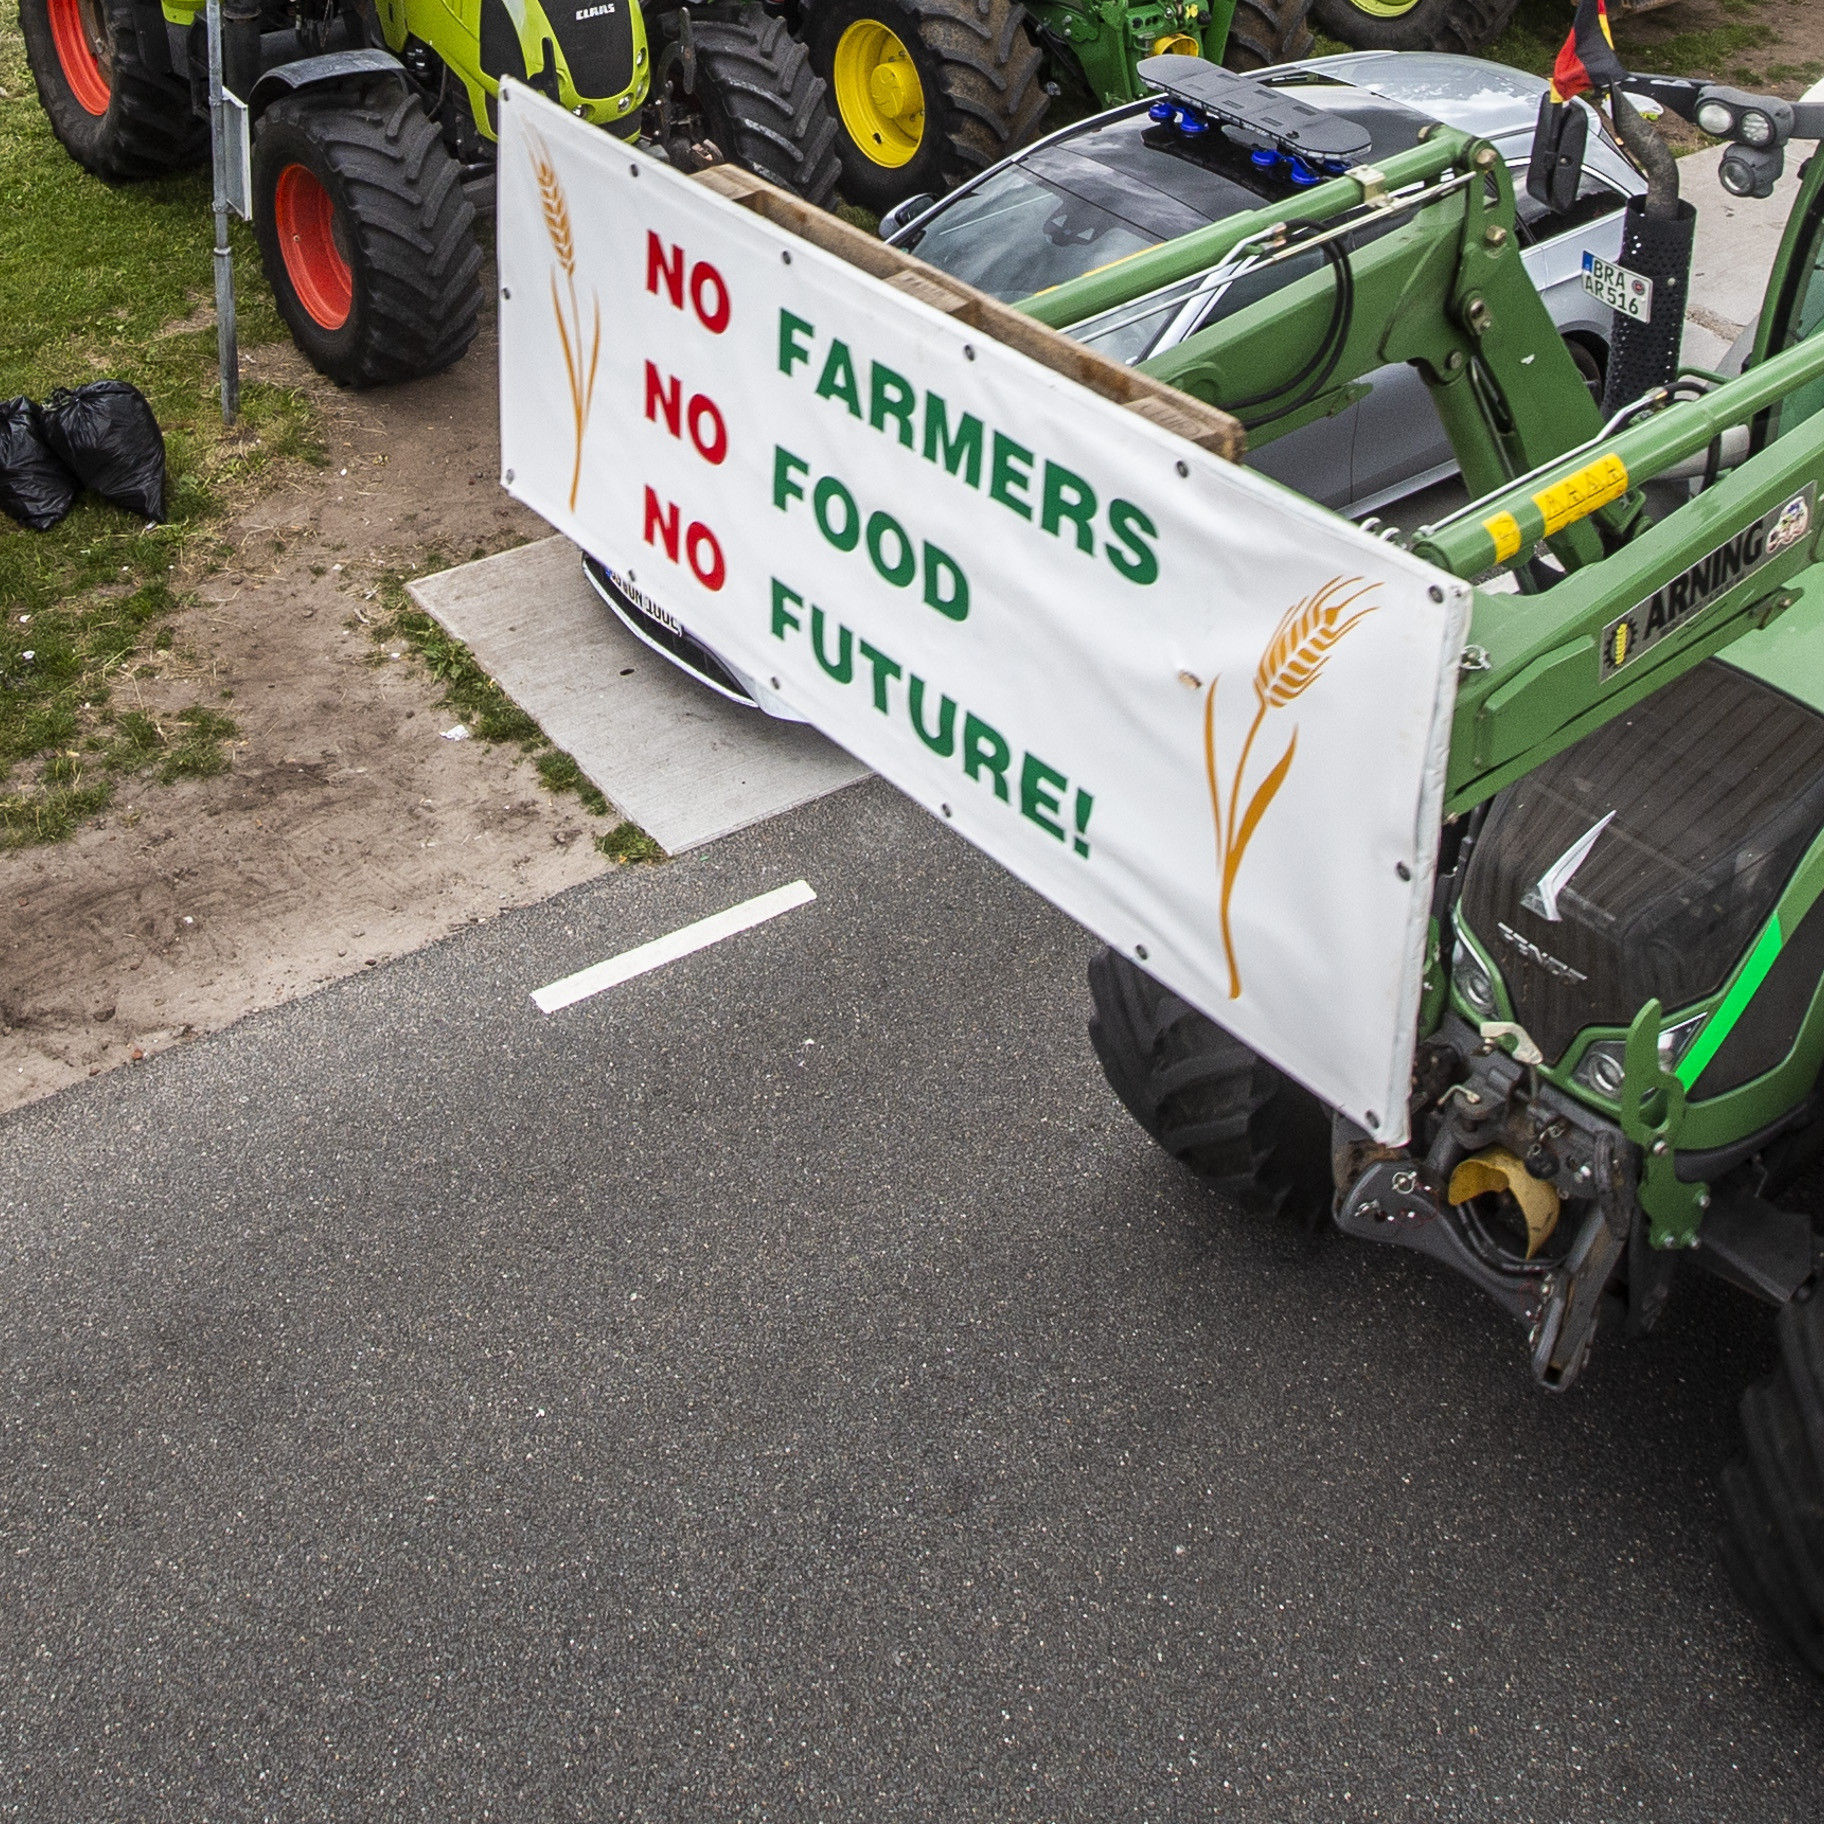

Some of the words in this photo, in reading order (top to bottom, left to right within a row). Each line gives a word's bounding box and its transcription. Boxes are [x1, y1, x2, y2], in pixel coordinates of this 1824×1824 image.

[575, 2, 616, 21] CLAAS
[1593, 259, 1626, 291] BRA
[645, 359, 729, 466] NO
[773, 445, 971, 622] FOOD
[646, 229, 732, 335] NO
[778, 308, 1161, 586] FARMERS
[643, 485, 727, 593] NO
[771, 578, 1095, 859] FUTURE!
[1643, 519, 1764, 641] ARNING
